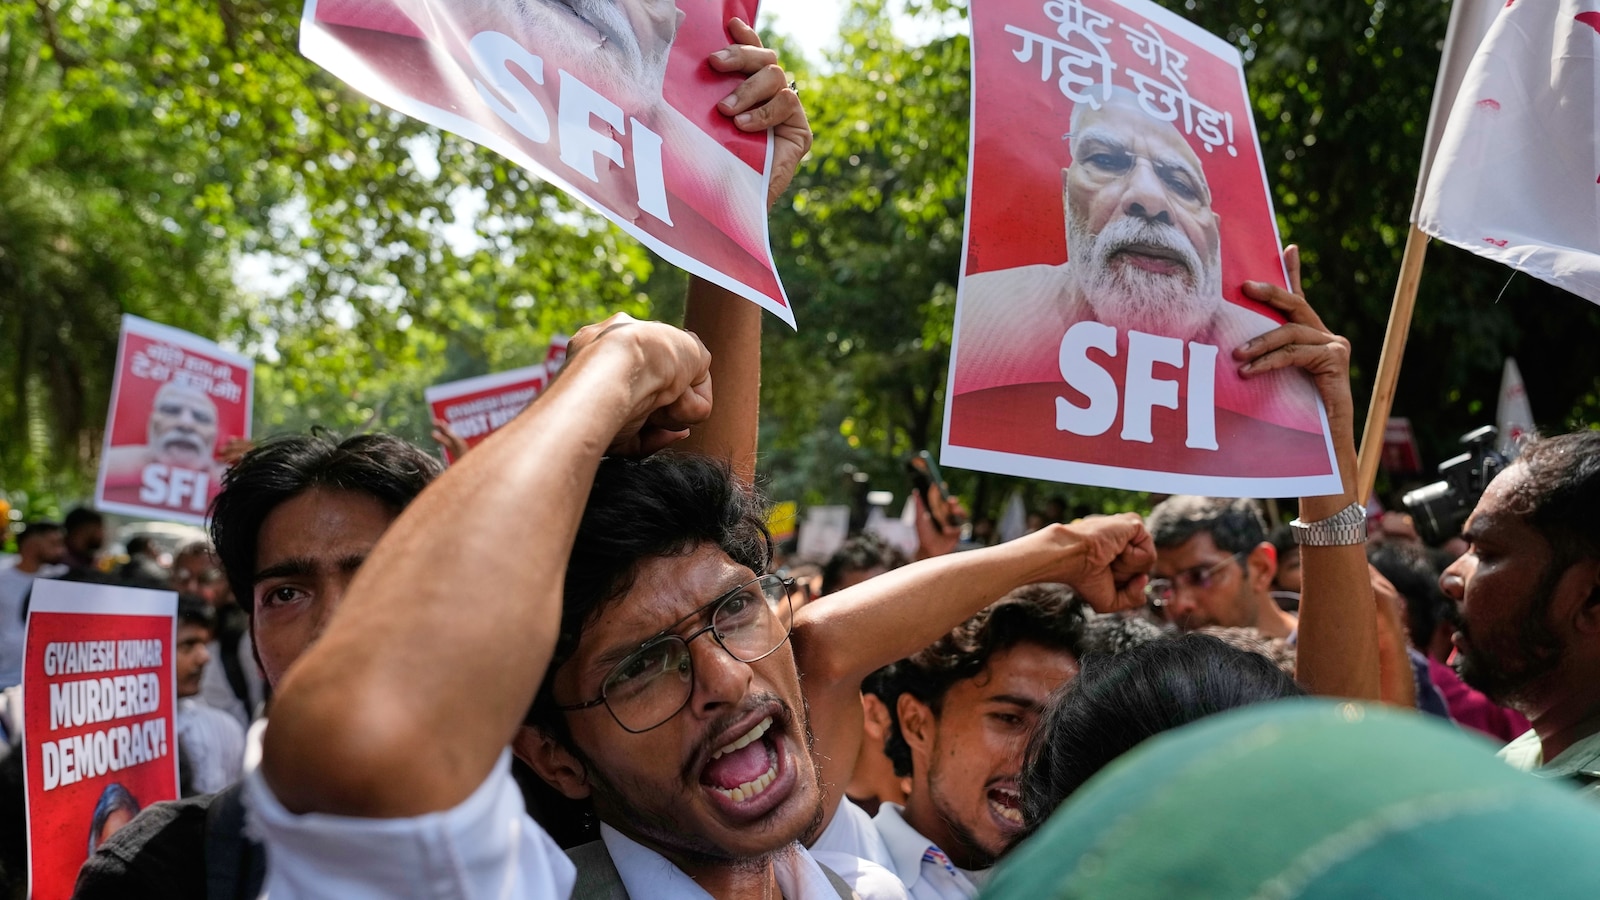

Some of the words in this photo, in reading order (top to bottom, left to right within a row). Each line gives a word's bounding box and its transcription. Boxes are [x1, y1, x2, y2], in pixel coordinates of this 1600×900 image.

[1119, 23, 1189, 81] चोर
[1004, 22, 1117, 110] गद्दी
[1126, 67, 1237, 157] छोड़!
[469, 30, 674, 228] SFI
[1055, 320, 1219, 451] SFI
[141, 464, 209, 510] SFI
[43, 640, 116, 677] GYANESH
[118, 638, 163, 670] KUMAR
[49, 672, 161, 731] MURDERED
[41, 717, 168, 792] DEMOCRACY!
